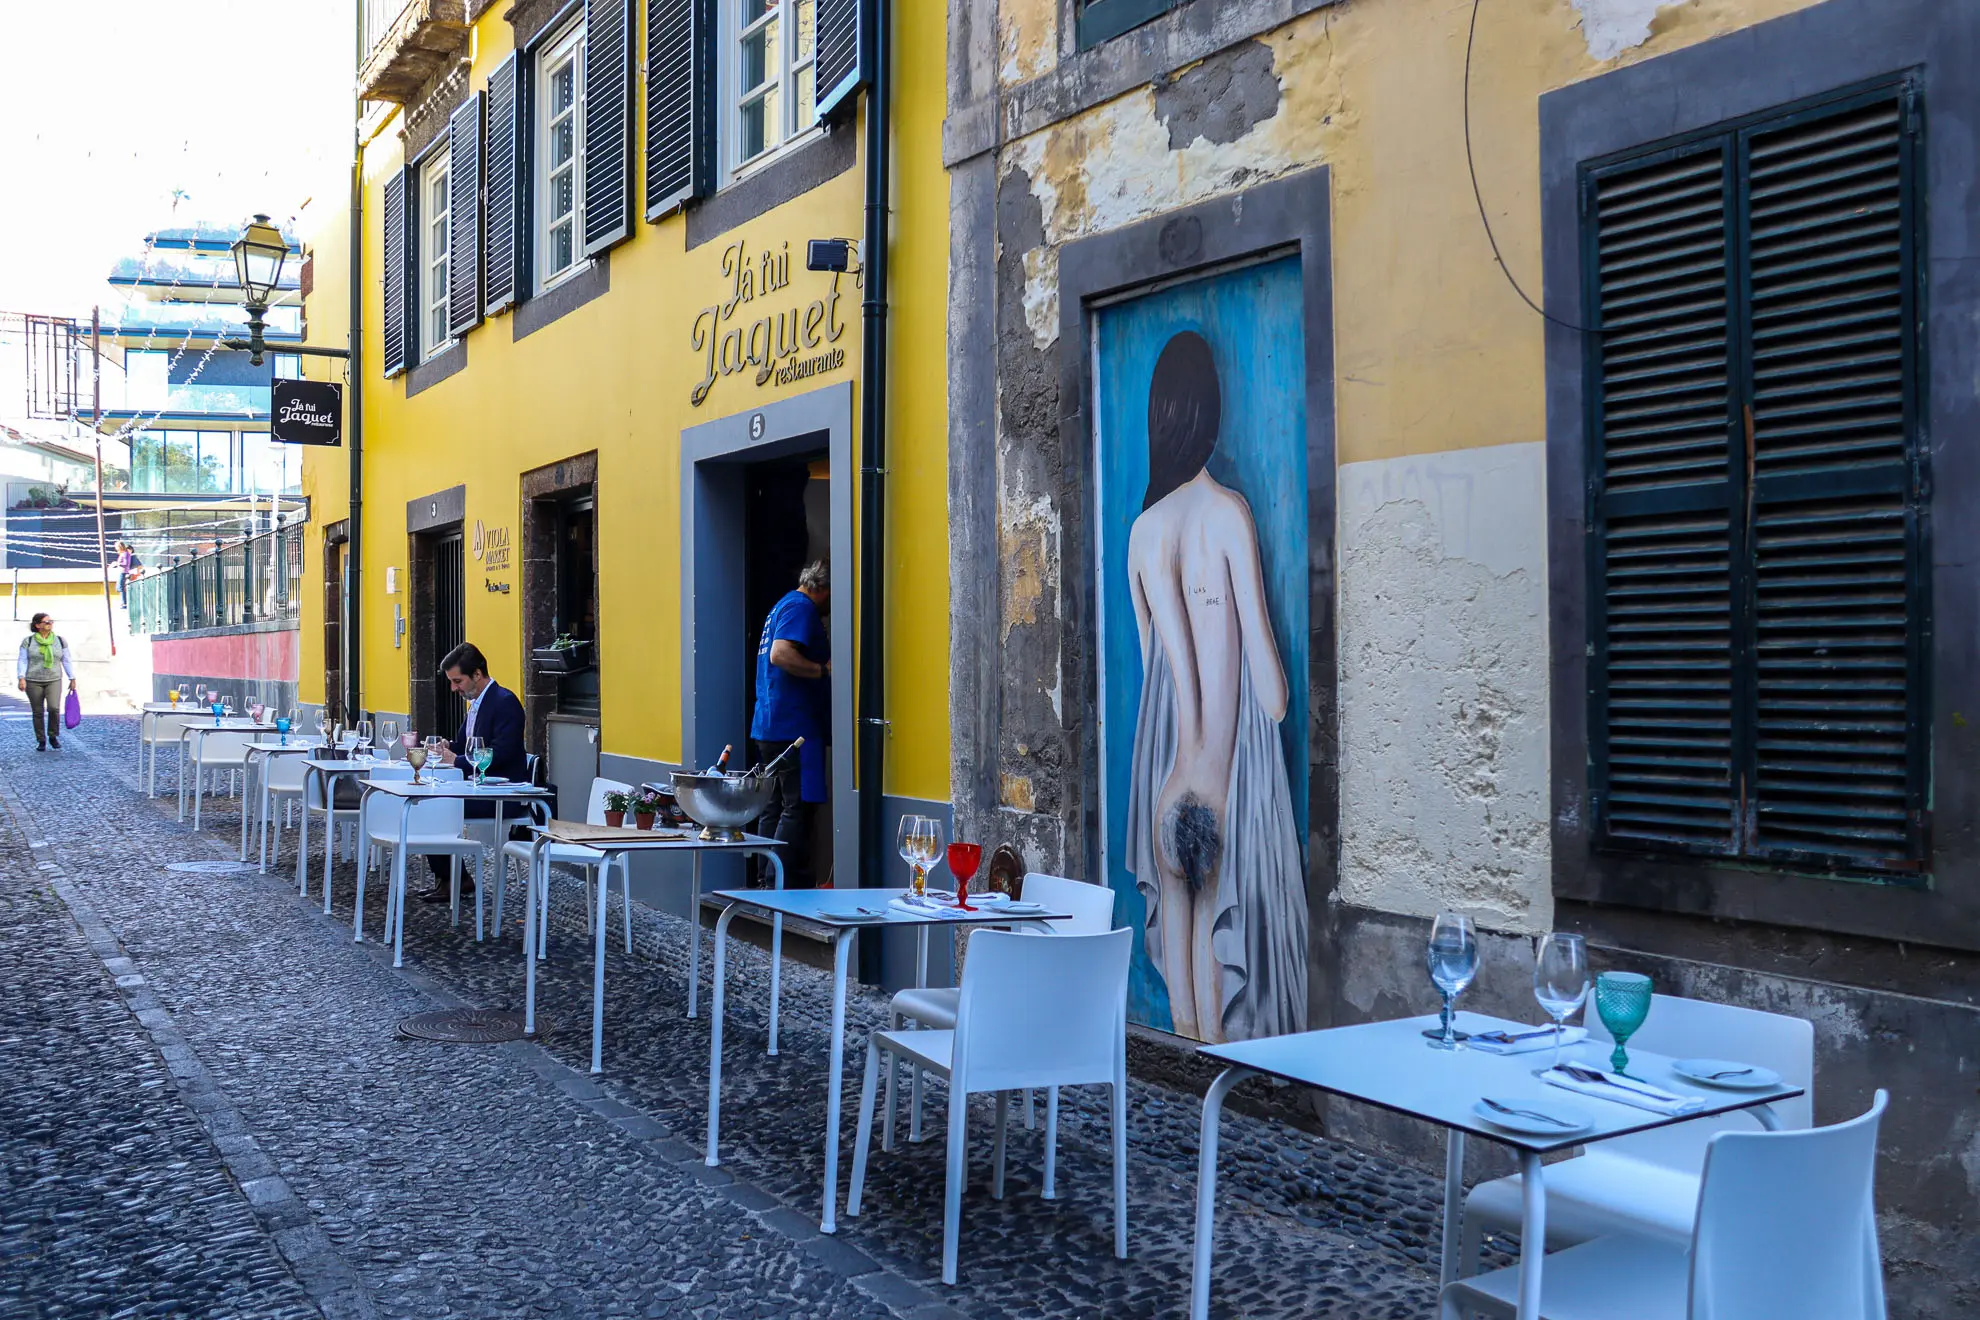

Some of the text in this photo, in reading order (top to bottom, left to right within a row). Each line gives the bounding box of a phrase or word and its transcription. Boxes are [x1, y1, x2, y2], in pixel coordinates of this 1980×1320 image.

[721, 240, 789, 321] Já fui
[690, 272, 844, 407] Jaquet
[774, 347, 844, 387] restaurante
[279, 406, 334, 425] Jaquet
[752, 416, 761, 438] 5
[486, 527, 510, 549] VIOLA
